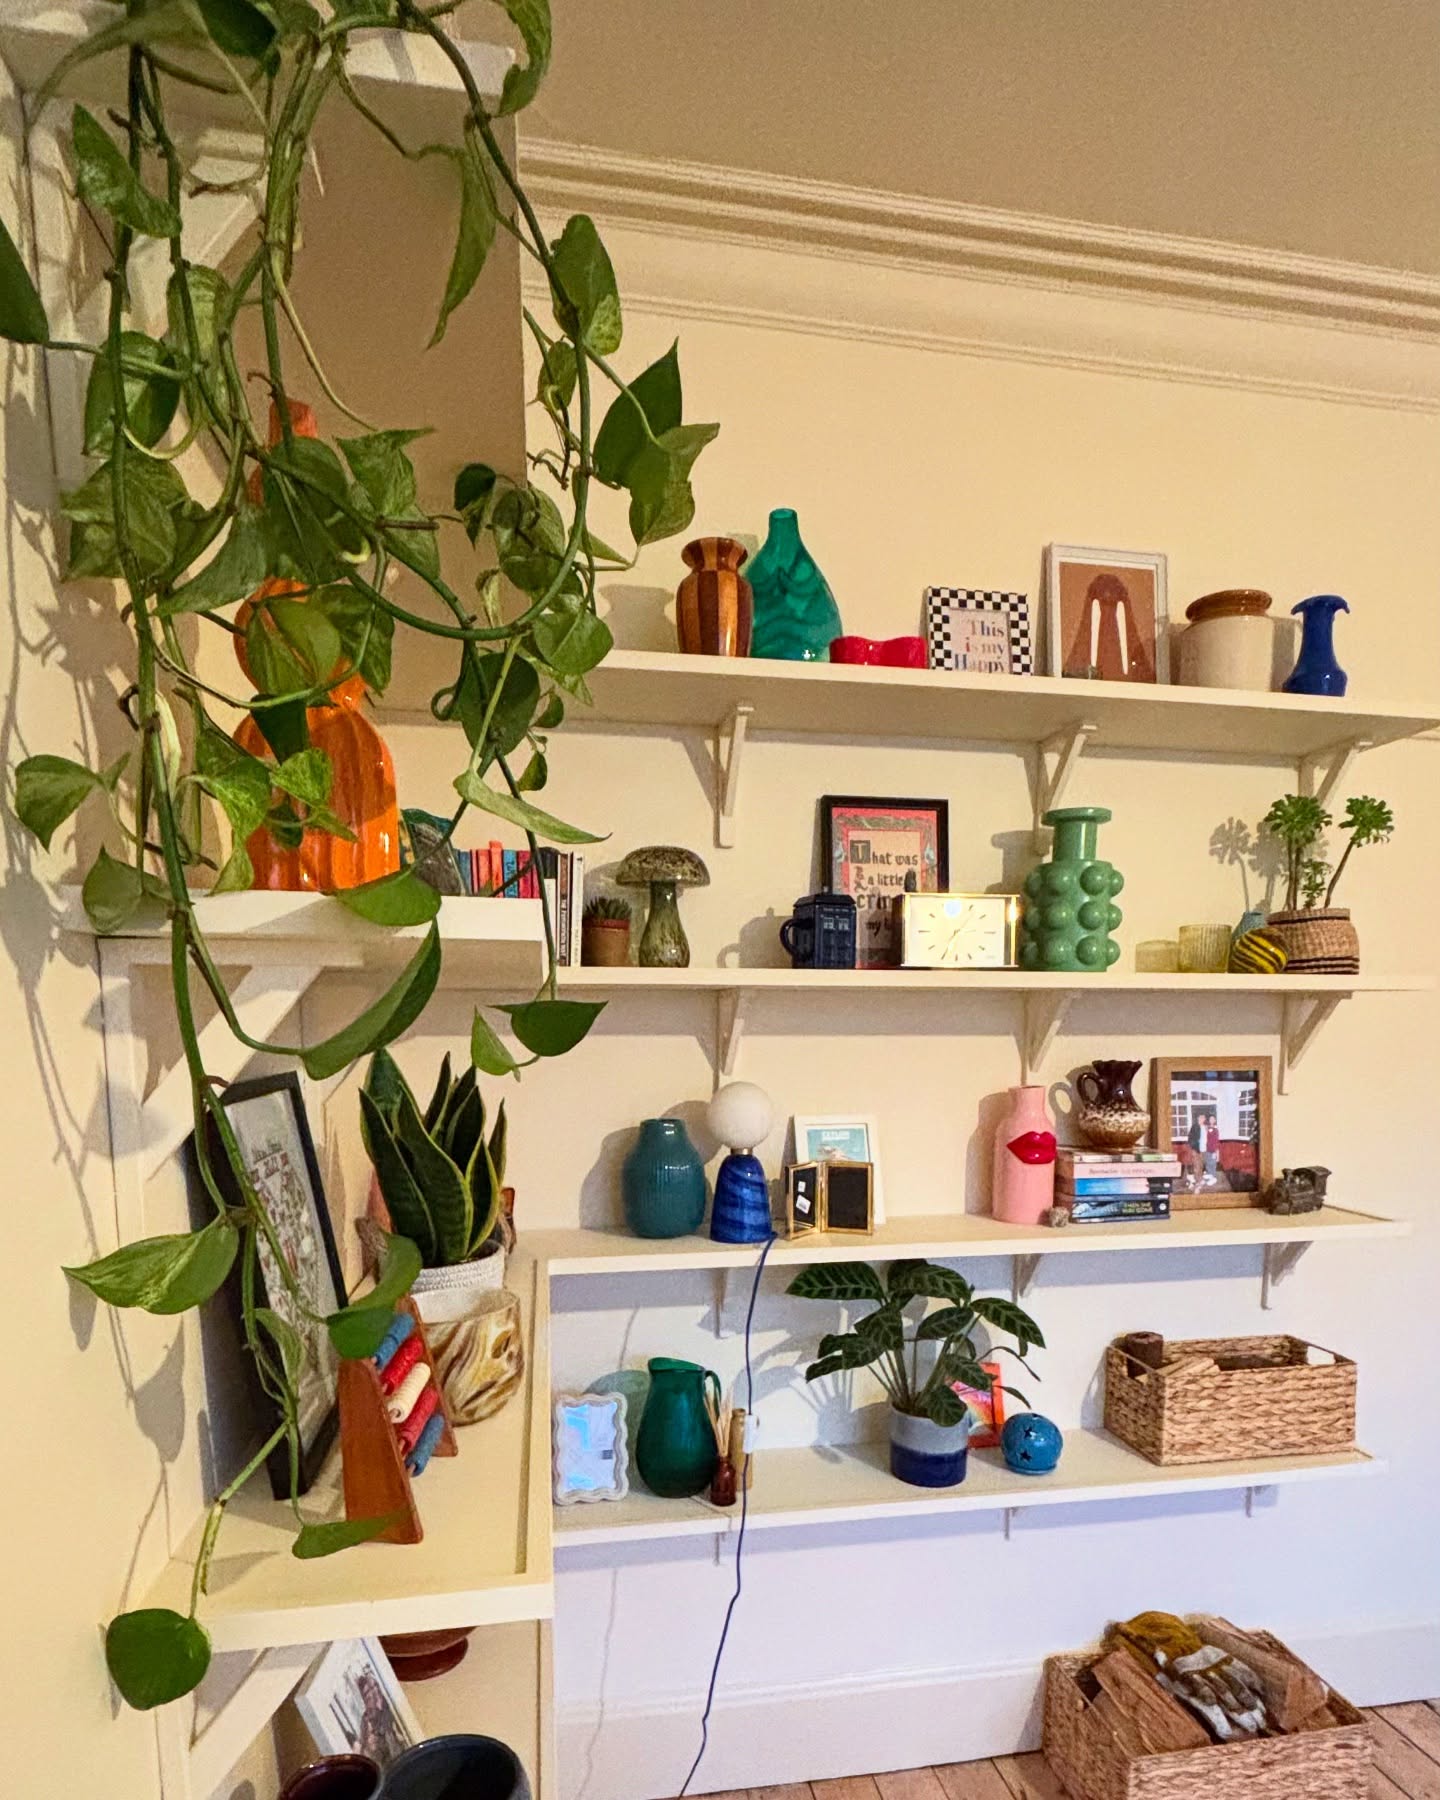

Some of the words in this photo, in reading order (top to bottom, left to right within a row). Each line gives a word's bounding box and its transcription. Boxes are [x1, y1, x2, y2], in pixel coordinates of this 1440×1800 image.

[967, 619, 1004, 637] This
[965, 636, 979, 653] is
[981, 643, 1005, 659] my
[954, 654, 1004, 673] Happy
[850, 840, 894, 865] That
[895, 853, 919, 865] was
[868, 877, 874, 885] a
[877, 872, 904, 887] little
